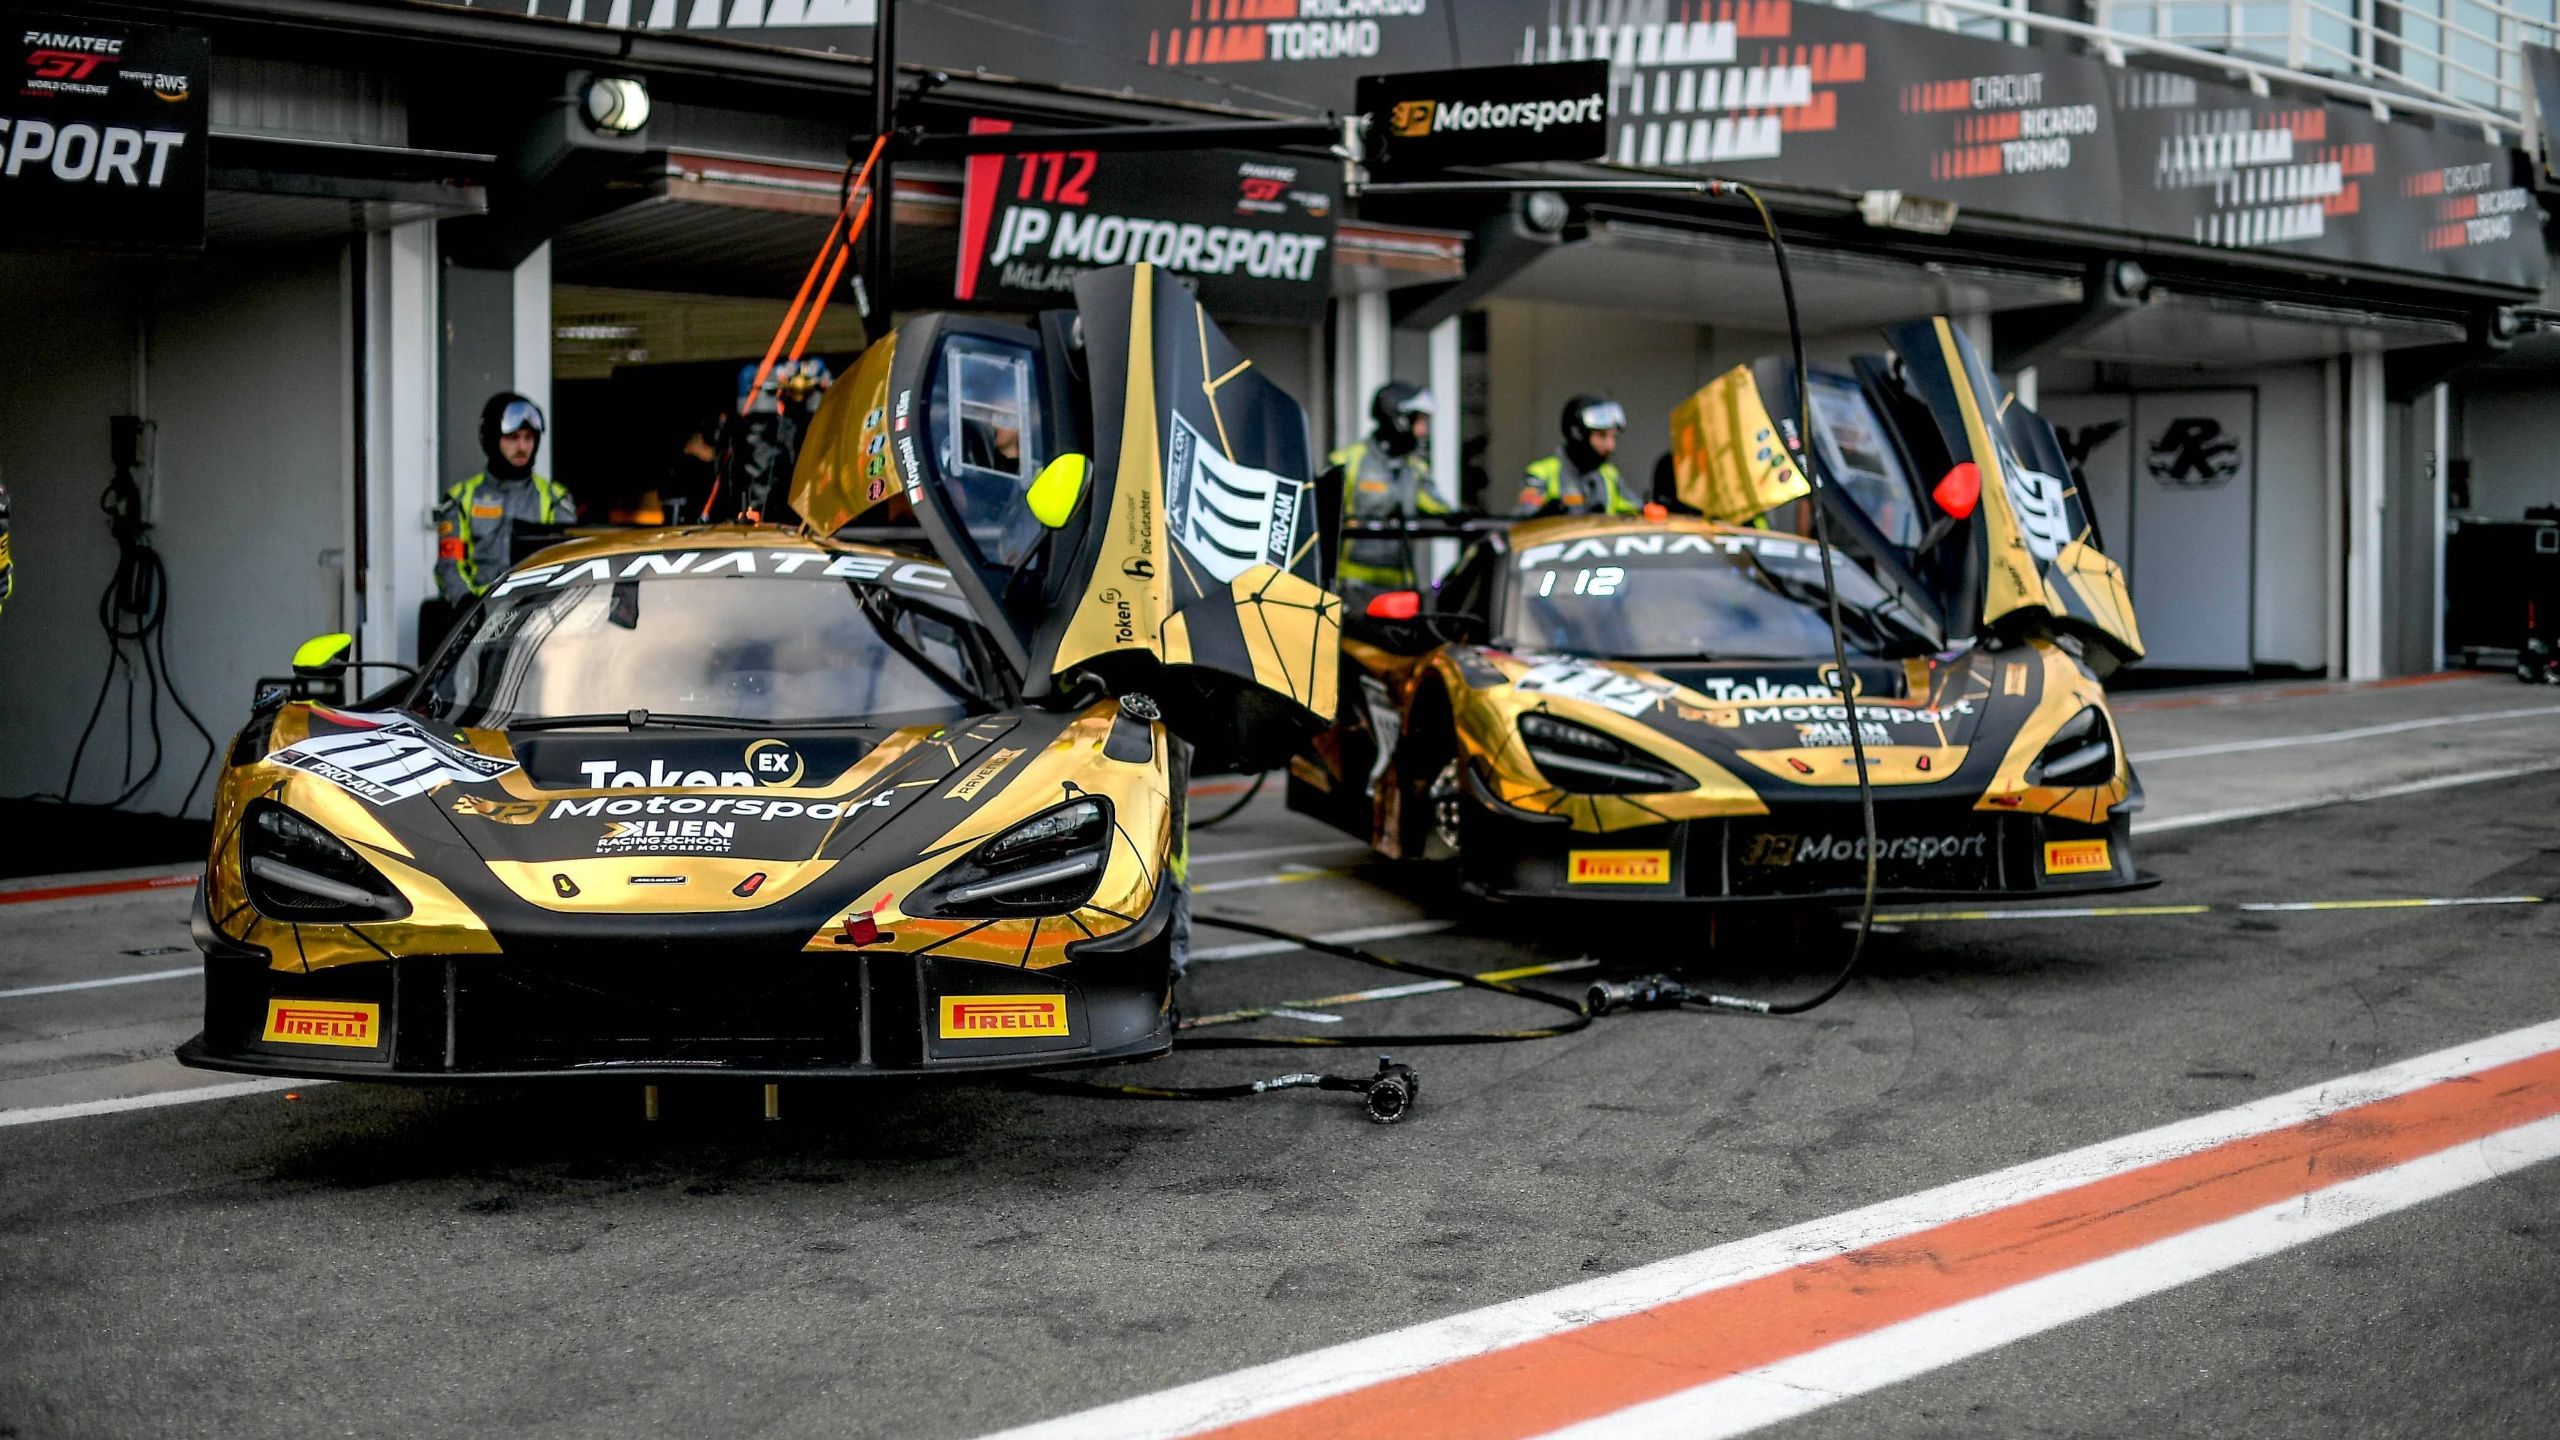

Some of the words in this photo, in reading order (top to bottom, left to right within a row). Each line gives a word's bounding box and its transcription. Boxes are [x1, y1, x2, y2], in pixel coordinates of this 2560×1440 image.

[23, 31, 124, 54] FANATEC
[1266, 20, 1381, 61] TORMO
[27, 79, 60, 92] WORLD
[61, 82, 109, 96] CHALLENGE
[154, 73, 189, 92] aws
[1971, 72, 2043, 109] CIRCUIT
[1433, 93, 1603, 132] Motorsport
[2021, 103, 2098, 138] RICARDO
[0, 117, 187, 187] PORT
[2001, 136, 2071, 173] TORMO
[1016, 151, 1098, 206] 112
[990, 205, 1051, 267] JP
[1050, 211, 1326, 281] MOTORSPORT
[1140, 490, 1152, 538] Gutachter
[1191, 459, 1266, 561] 111
[1269, 492, 1295, 557] PRO-AM
[1141, 539, 1153, 555] Die
[1518, 535, 1842, 570] FANATEC
[491, 551, 952, 599] FANATEC
[1114, 600, 1134, 643] Token
[1705, 676, 1833, 702] Token
[1744, 700, 1974, 725] Motorsport
[310, 762, 386, 797] PRO-AM
[315, 738, 462, 786] 111
[580, 760, 755, 788] Token
[758, 753, 790, 772] EX
[958, 752, 1014, 794] RAVENOL
[548, 788, 895, 823] Motorsport
[597, 837, 661, 847] RACING
[663, 836, 731, 846] SCHOOL
[603, 820, 735, 838] KLIEN
[595, 845, 612, 854] by
[637, 844, 731, 852] MOTORSPORT
[1578, 856, 1660, 876] PIRELLI
[1796, 832, 1987, 866] Motorsport
[2051, 847, 2105, 867] PIRELLI
[274, 1008, 369, 1038] PIRELLI
[953, 1003, 1055, 1030] PIRELLI
